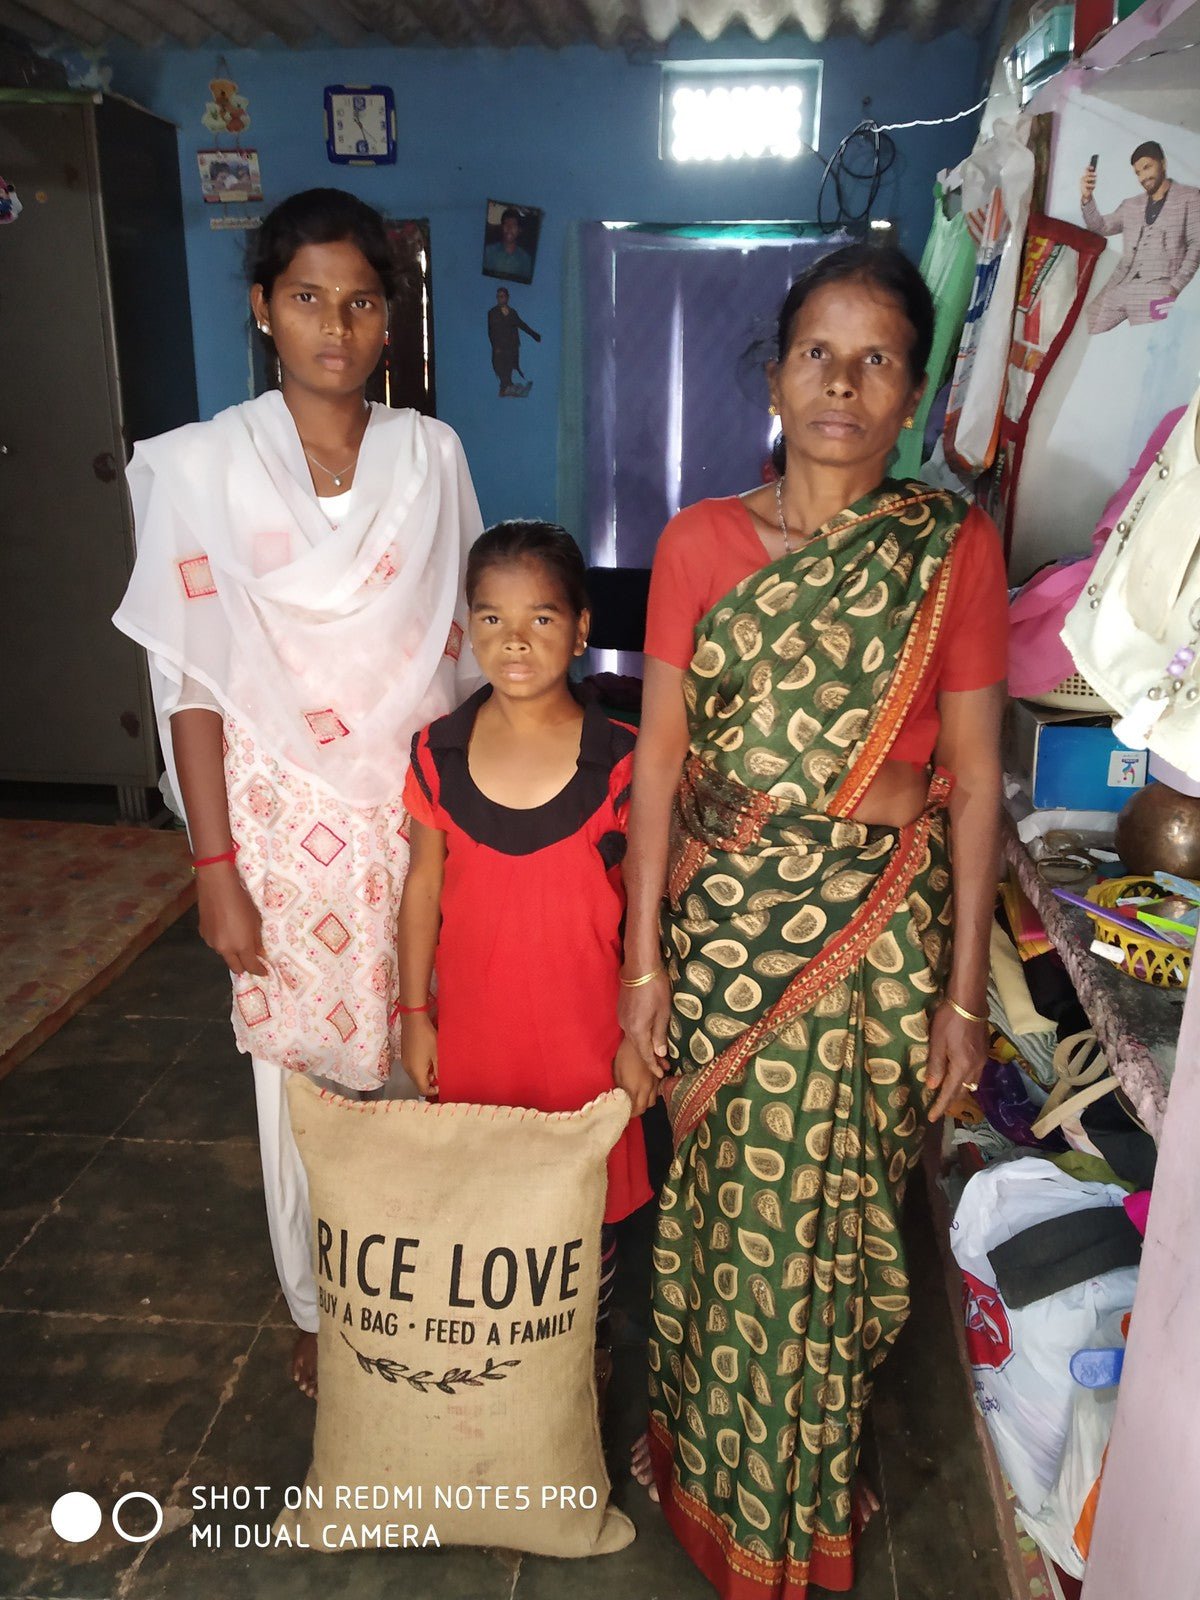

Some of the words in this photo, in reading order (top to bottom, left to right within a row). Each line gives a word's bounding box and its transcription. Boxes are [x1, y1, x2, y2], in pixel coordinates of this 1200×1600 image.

[317, 1218, 420, 1302] RICE
[448, 1238, 583, 1310] LOVE
[319, 1285, 338, 1318] BUY
[343, 1302, 353, 1326] A
[360, 1307, 398, 1336] BAG
[425, 1318, 475, 1345] FEED
[486, 1322, 501, 1346] A
[510, 1308, 576, 1345] FAMILY
